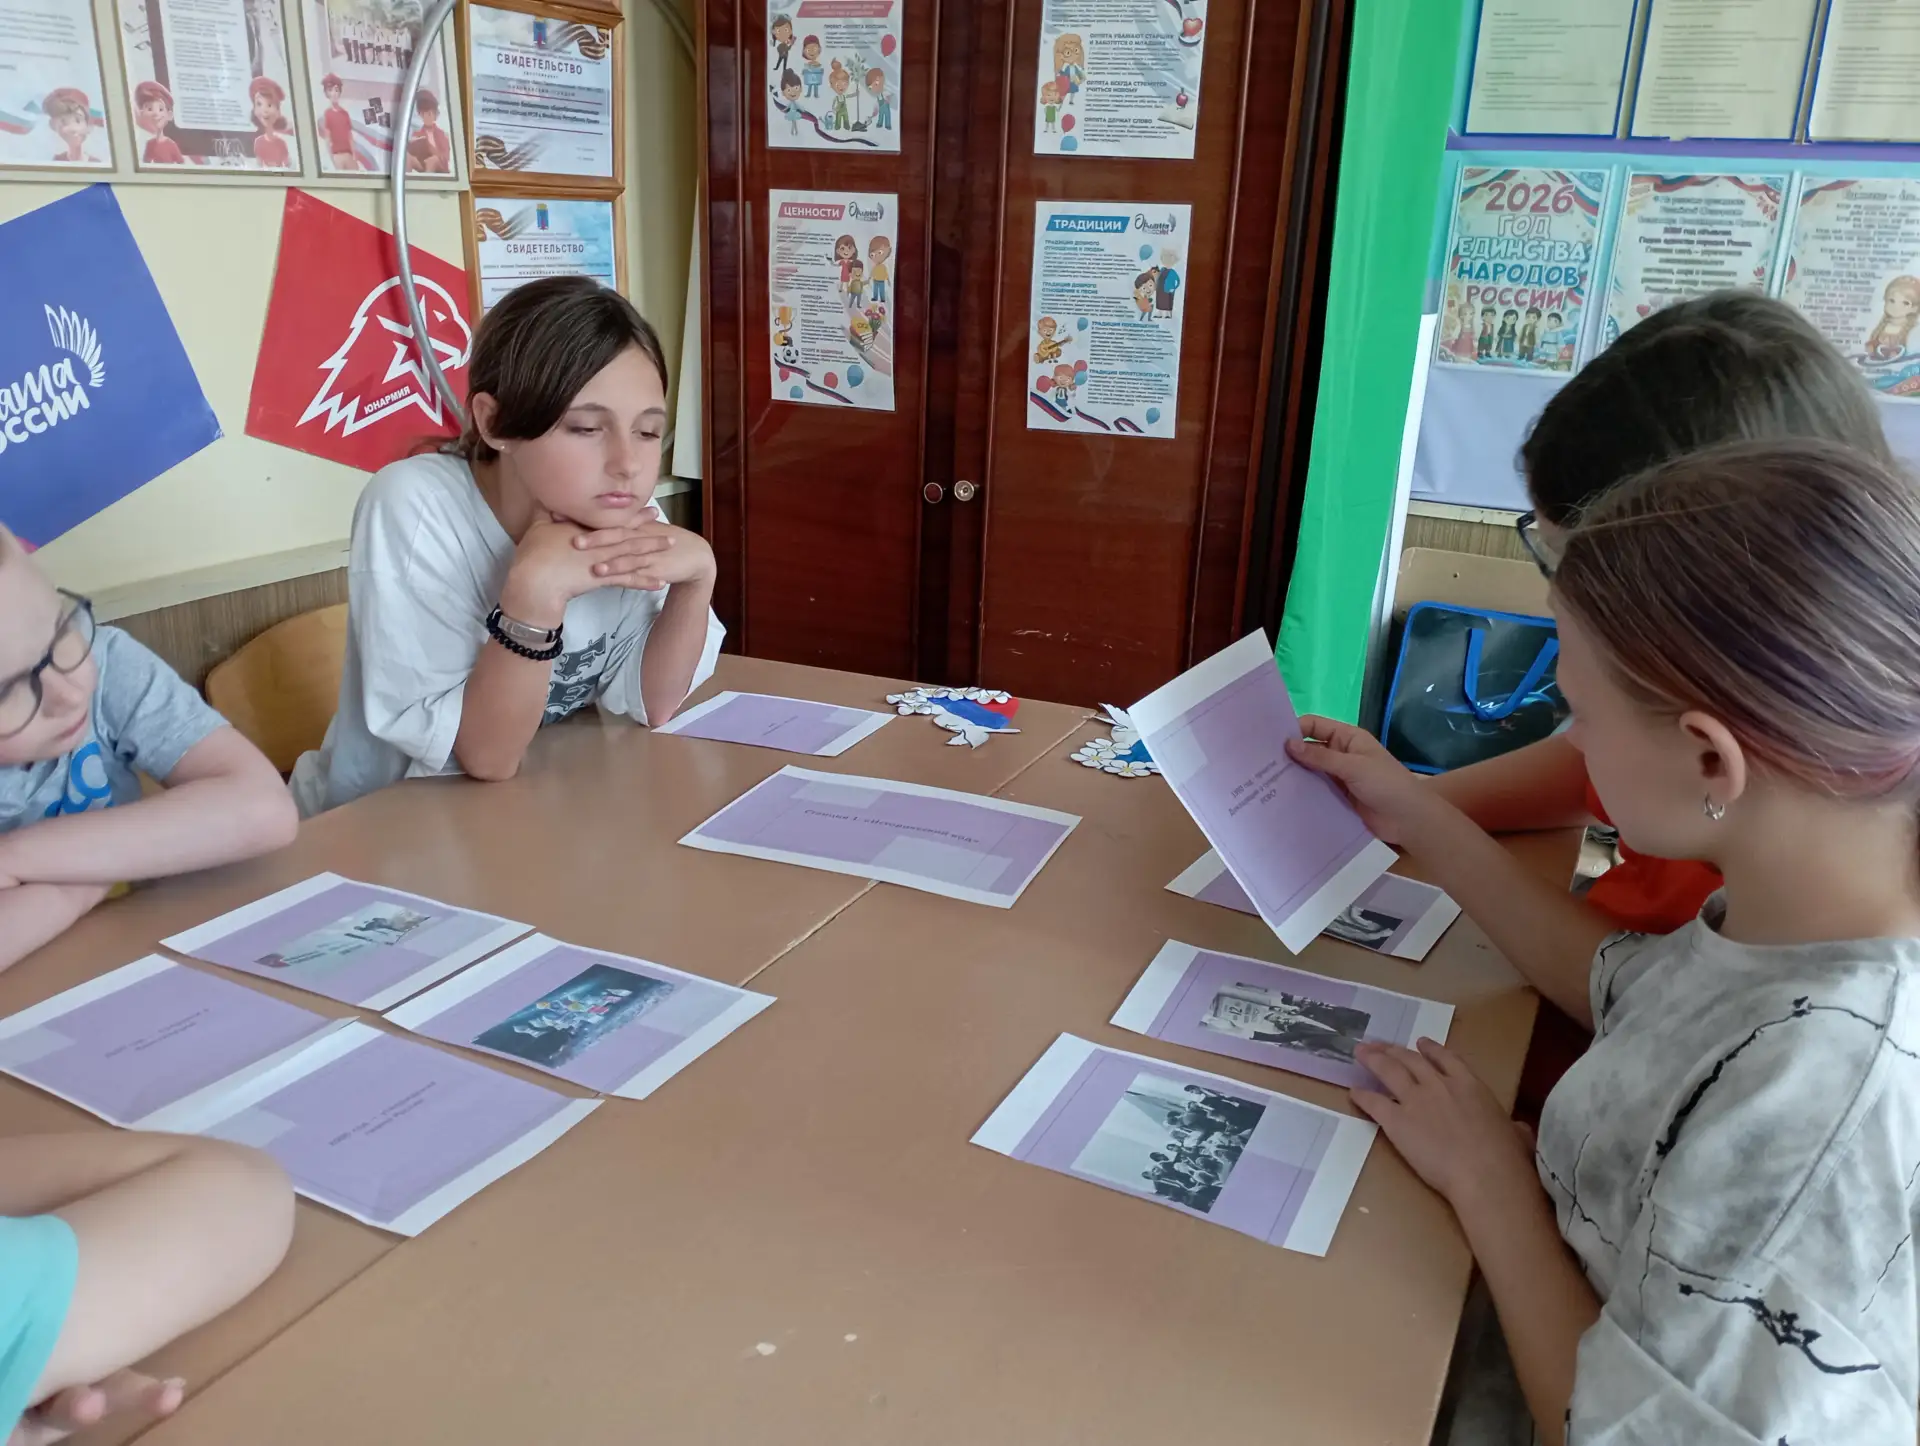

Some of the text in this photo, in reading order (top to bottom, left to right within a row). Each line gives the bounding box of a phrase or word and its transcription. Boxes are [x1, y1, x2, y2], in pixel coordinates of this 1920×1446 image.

[496, 52, 583, 75] СВИДЕТЕЛЬСТВО
[1485, 182, 1575, 214] 2026
[783, 206, 840, 218] ЦЕННОСТИ
[1053, 219, 1122, 231] ТРАДИЦИИ
[1498, 214, 1552, 240] ГОД
[506, 244, 584, 255] СВИДЕТЕЛЬСТВО
[1458, 237, 1588, 263] ЕДИНСТВА
[1457, 261, 1580, 287] НАРОДОВ
[1466, 285, 1564, 310] РОССИИ
[363, 385, 411, 415] ЮНАРМИЯ
